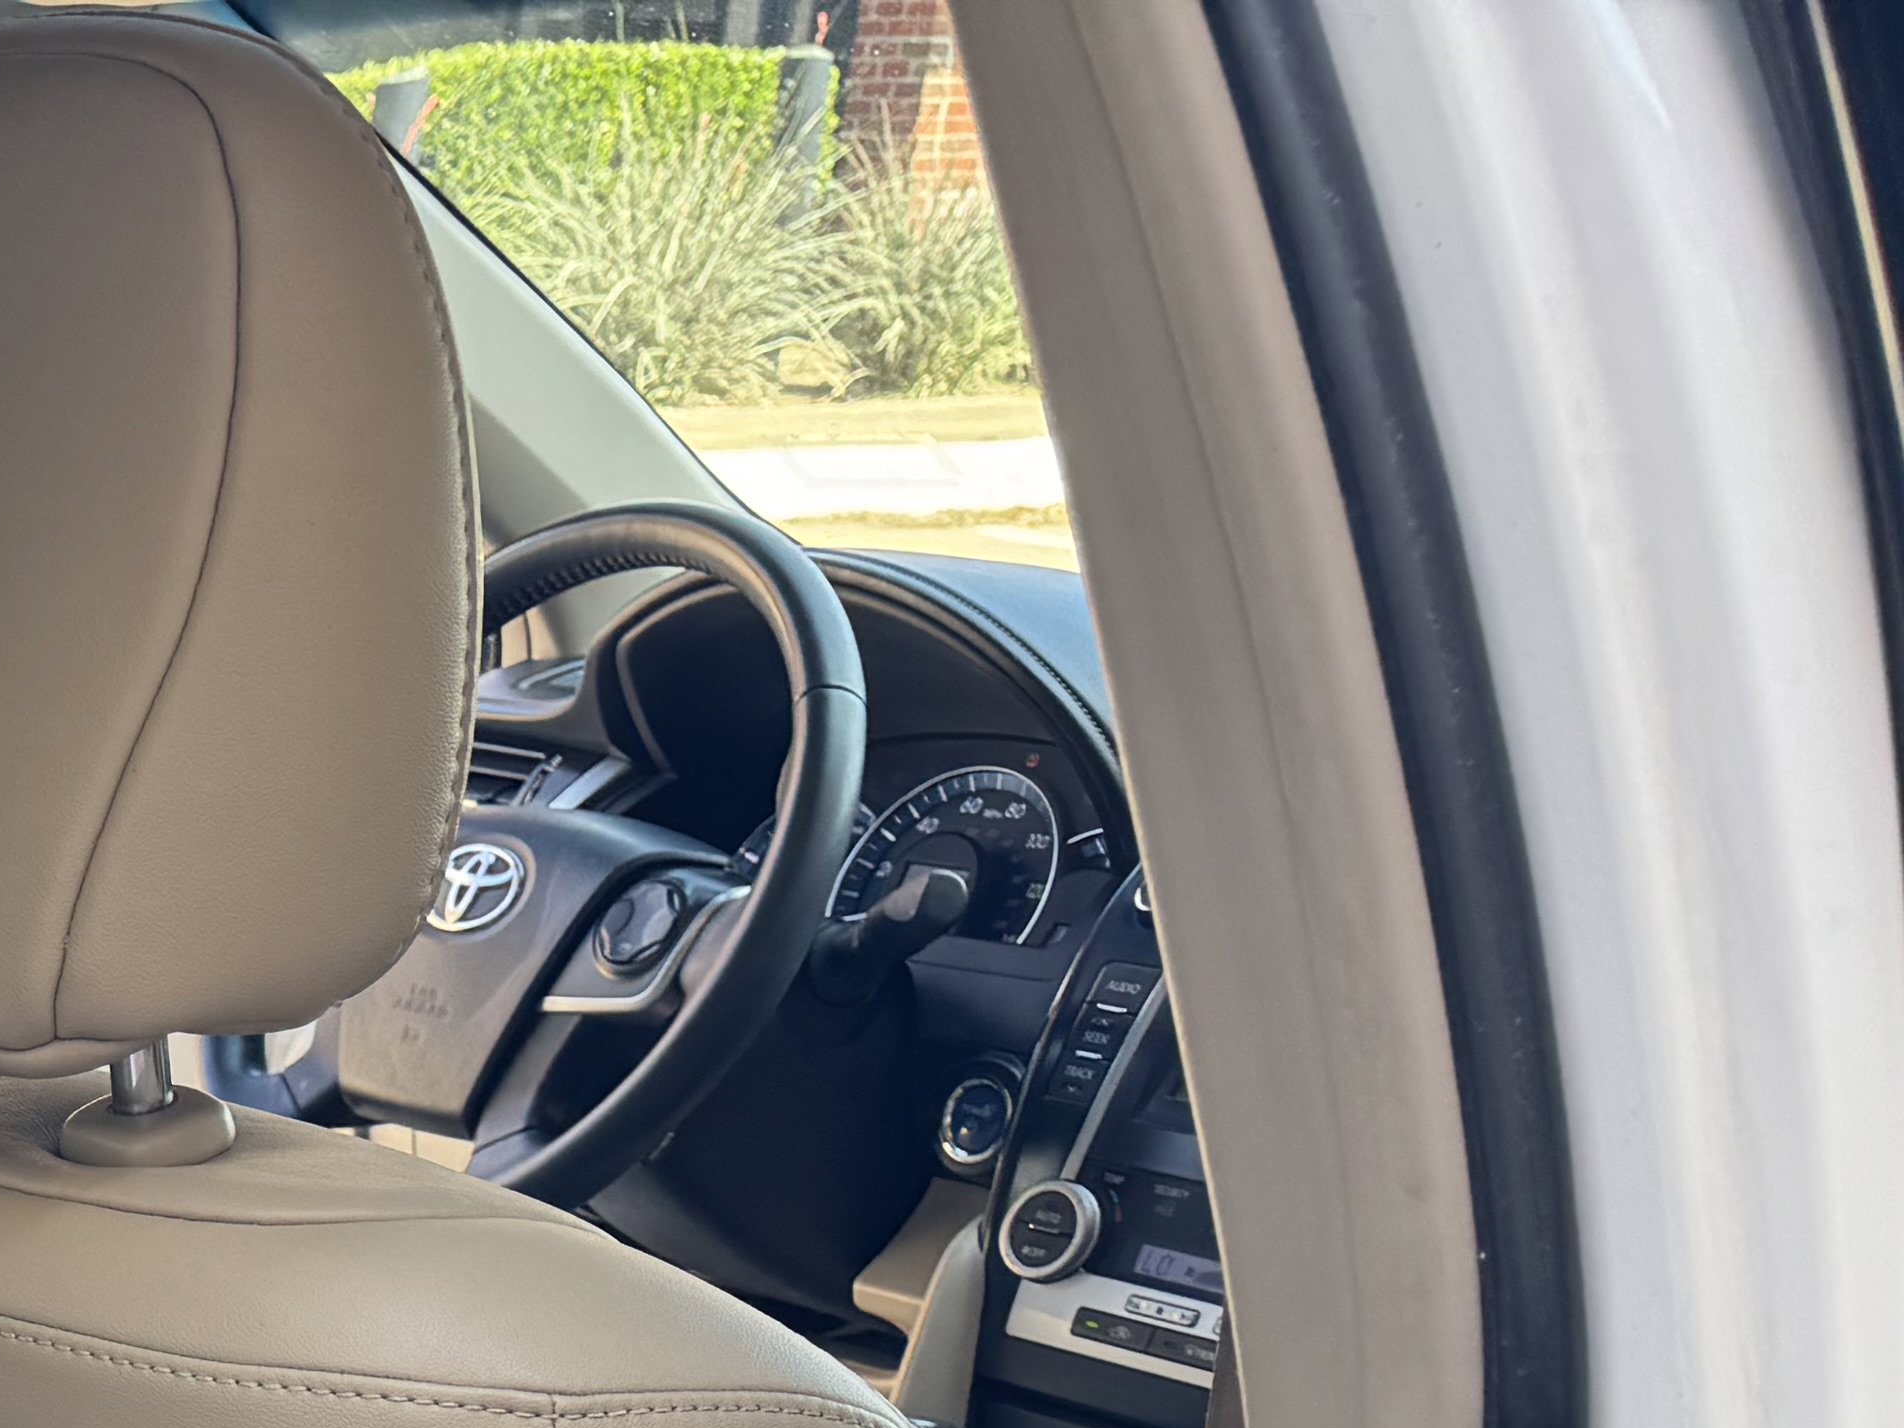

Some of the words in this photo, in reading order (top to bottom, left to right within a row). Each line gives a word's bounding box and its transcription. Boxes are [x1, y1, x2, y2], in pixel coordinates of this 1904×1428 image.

[1106, 979, 1141, 995] AUDIO
[1083, 1030, 1111, 1044] SEEK
[1064, 1065, 1094, 1080] TRACK
